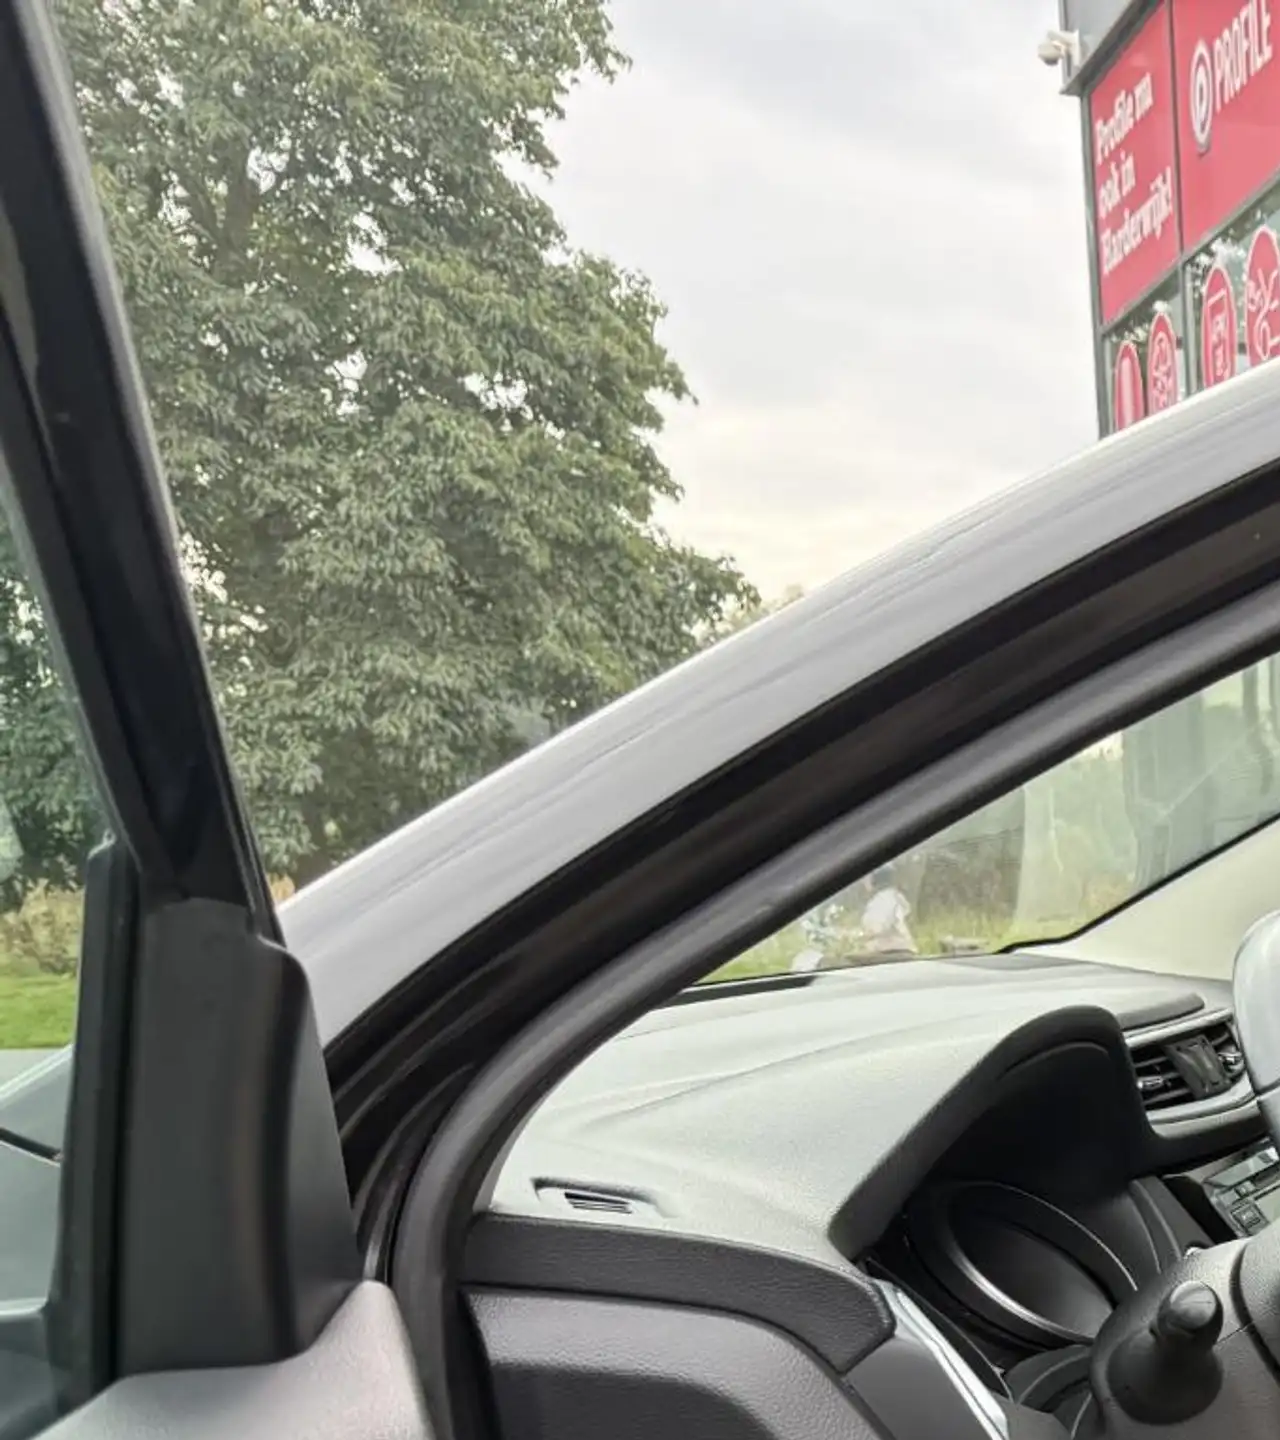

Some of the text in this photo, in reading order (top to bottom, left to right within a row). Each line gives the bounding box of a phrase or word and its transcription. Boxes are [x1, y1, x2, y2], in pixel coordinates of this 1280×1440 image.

[1213, 0, 1273, 113] PROFILE
[1096, 88, 1134, 165] Profile
[1100, 149, 1136, 219] ook in
